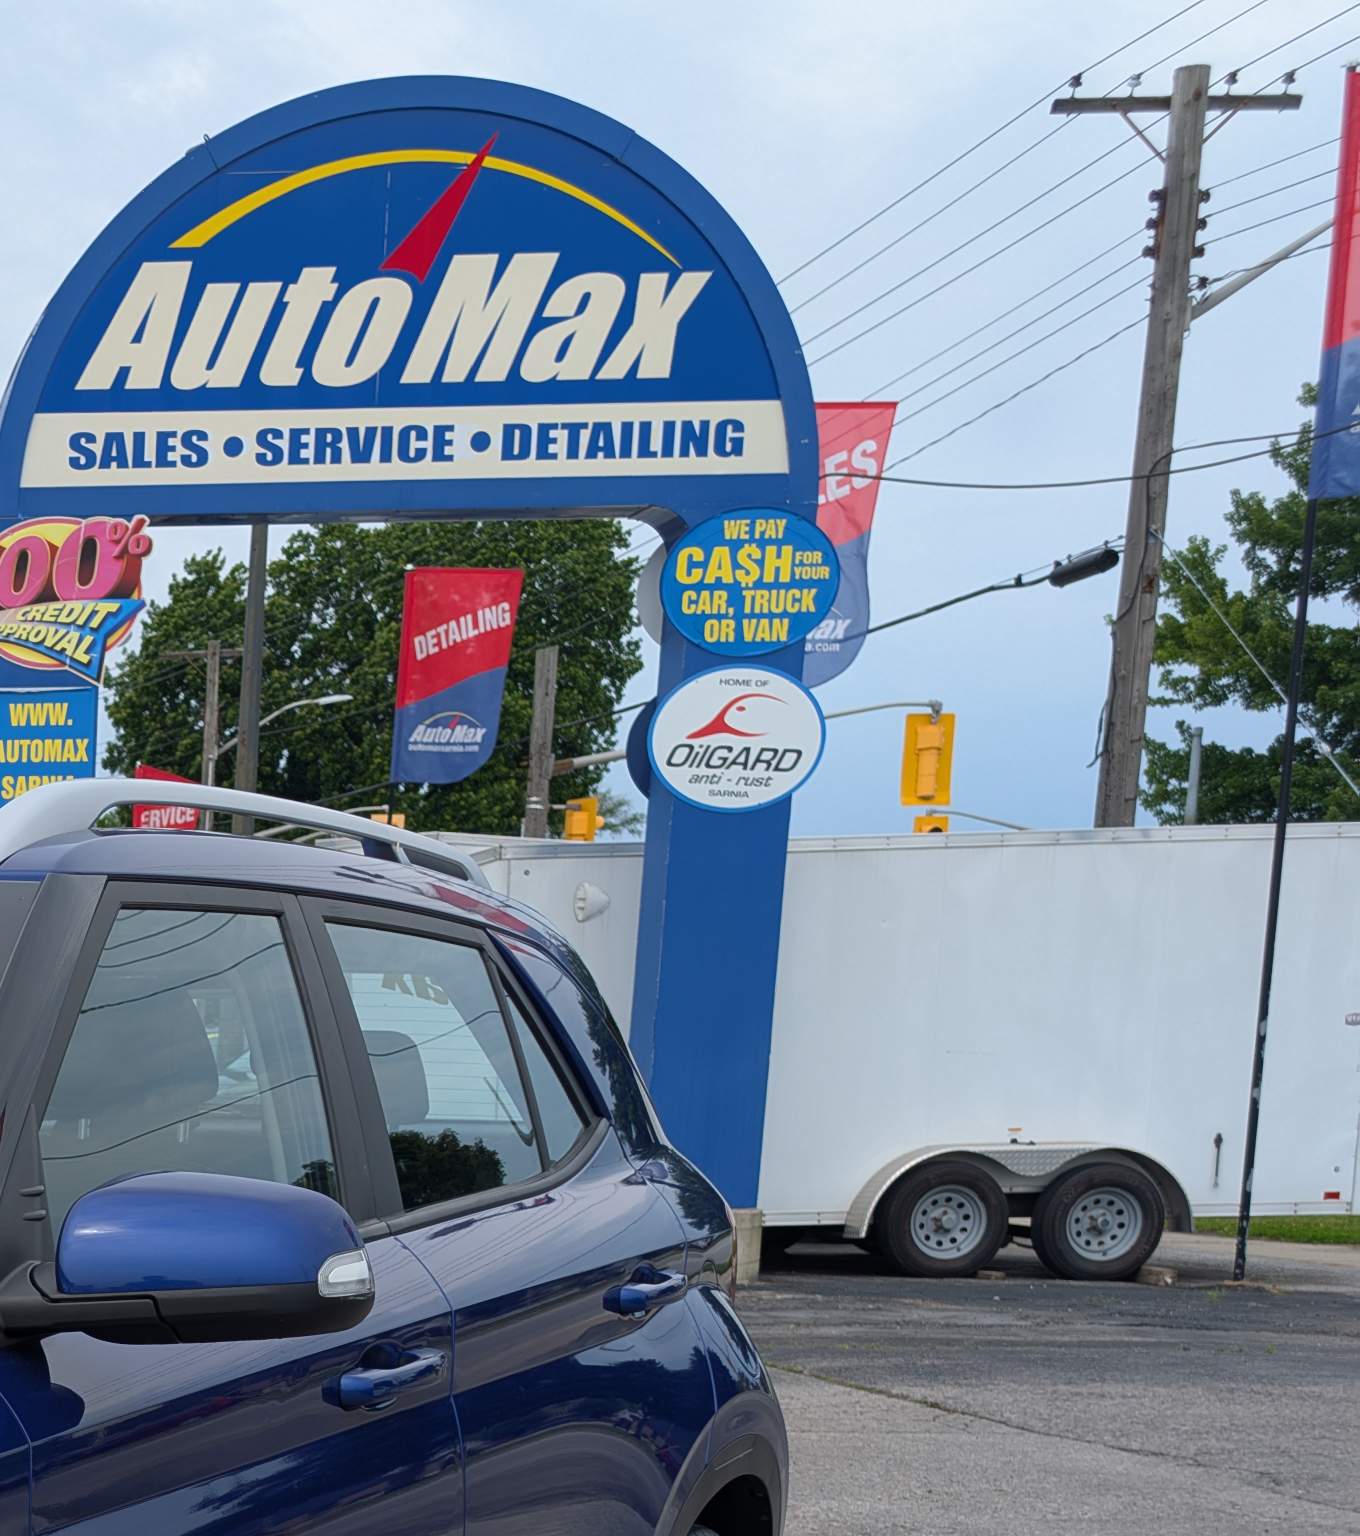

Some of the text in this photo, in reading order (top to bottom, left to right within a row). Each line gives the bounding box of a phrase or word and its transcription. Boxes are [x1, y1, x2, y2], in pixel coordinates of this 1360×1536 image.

[74, 252, 714, 391] AutoMax
[68, 418, 745, 471] SALES SERVICE DETAILING
[818, 439, 878, 505] ES
[723, 518, 788, 541] WE PAY
[675, 543, 823, 588] CA$H FOR
[793, 565, 830, 581] YOUR
[15, 602, 122, 629] CREDIT
[681, 588, 818, 617] CAR, TRUCK
[413, 601, 512, 662] DETAILING
[704, 618, 790, 643] OR VAN
[719, 678, 769, 688] HOME OF
[8, 702, 73, 727] WWW.
[408, 723, 487, 744] AutoMax
[665, 743, 803, 773] OilGARD
[688, 771, 725, 786] anti
[735, 774, 774, 788] rust
[707, 789, 750, 799] SARNIA
